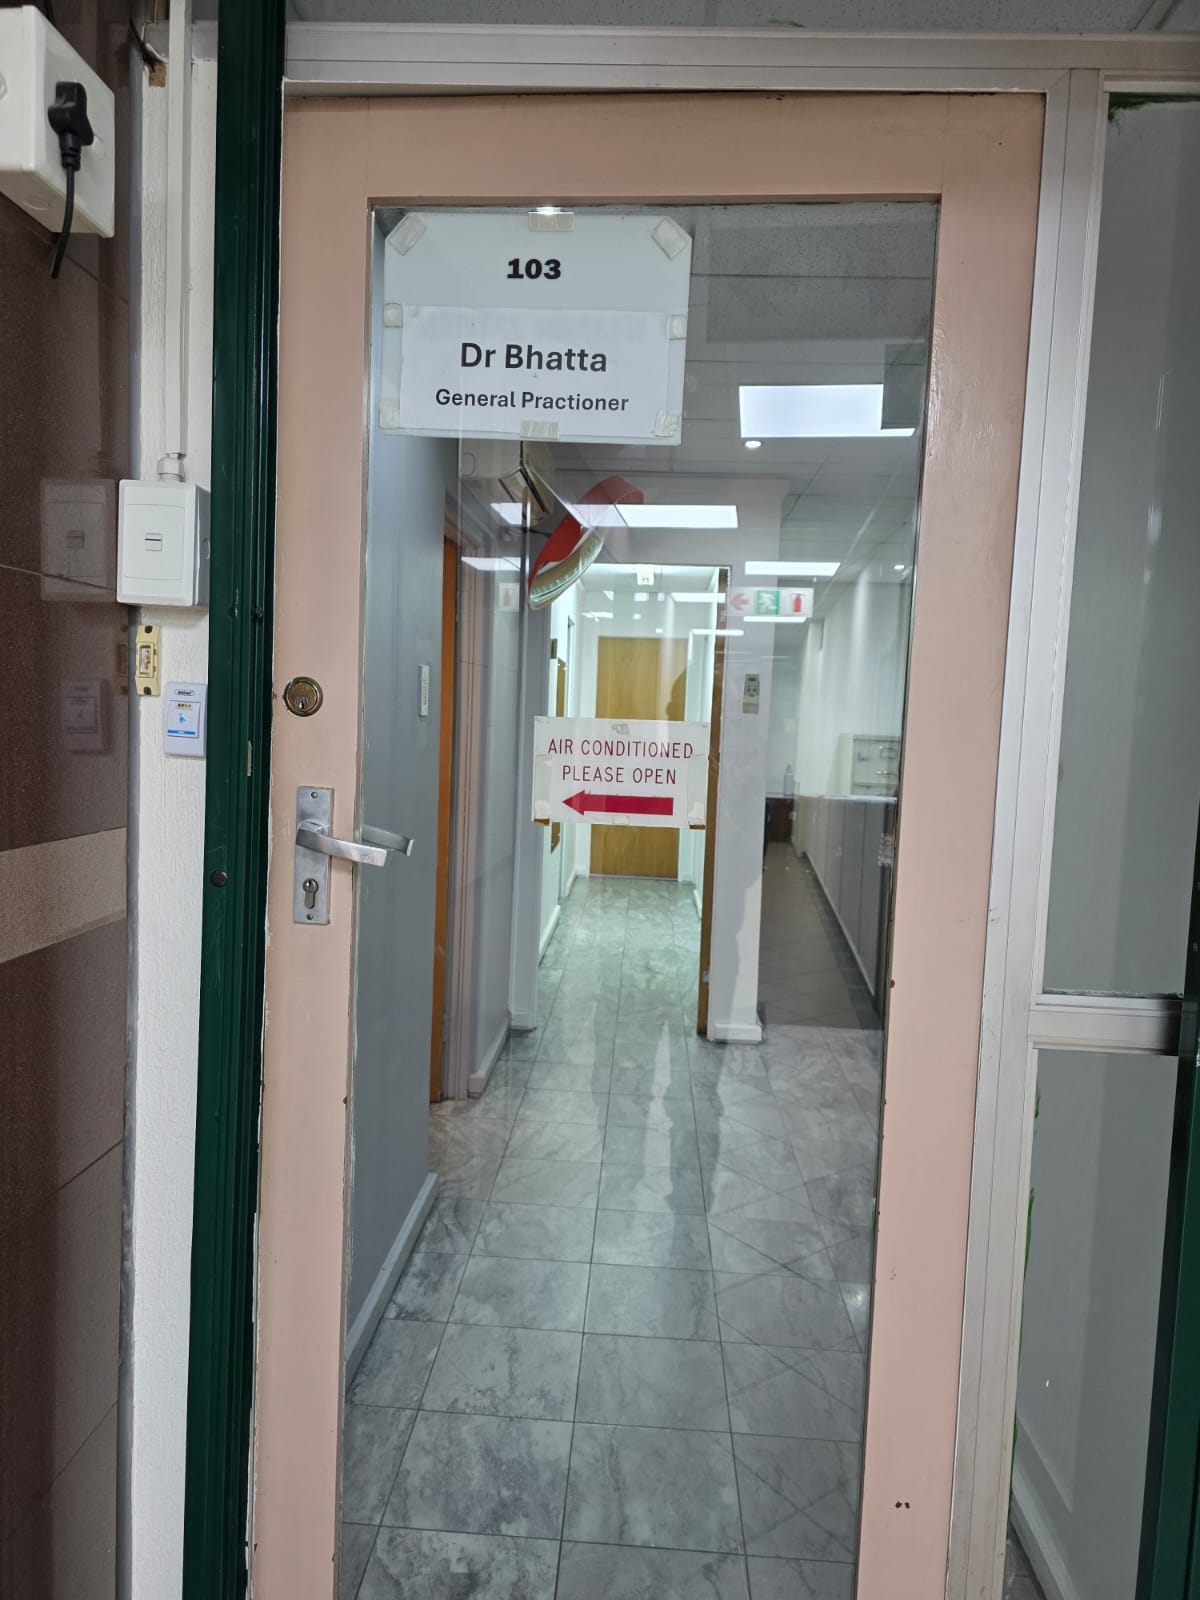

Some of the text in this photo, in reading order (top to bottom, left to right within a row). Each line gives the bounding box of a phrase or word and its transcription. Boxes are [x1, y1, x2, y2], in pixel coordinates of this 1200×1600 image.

[507, 258, 562, 280] 103
[461, 342, 607, 373] Dr Bhatta
[435, 388, 629, 411] General Practioner
[548, 738, 693, 759] AIR CONDITIONED
[562, 765, 676, 785] PLEASE OPEN
